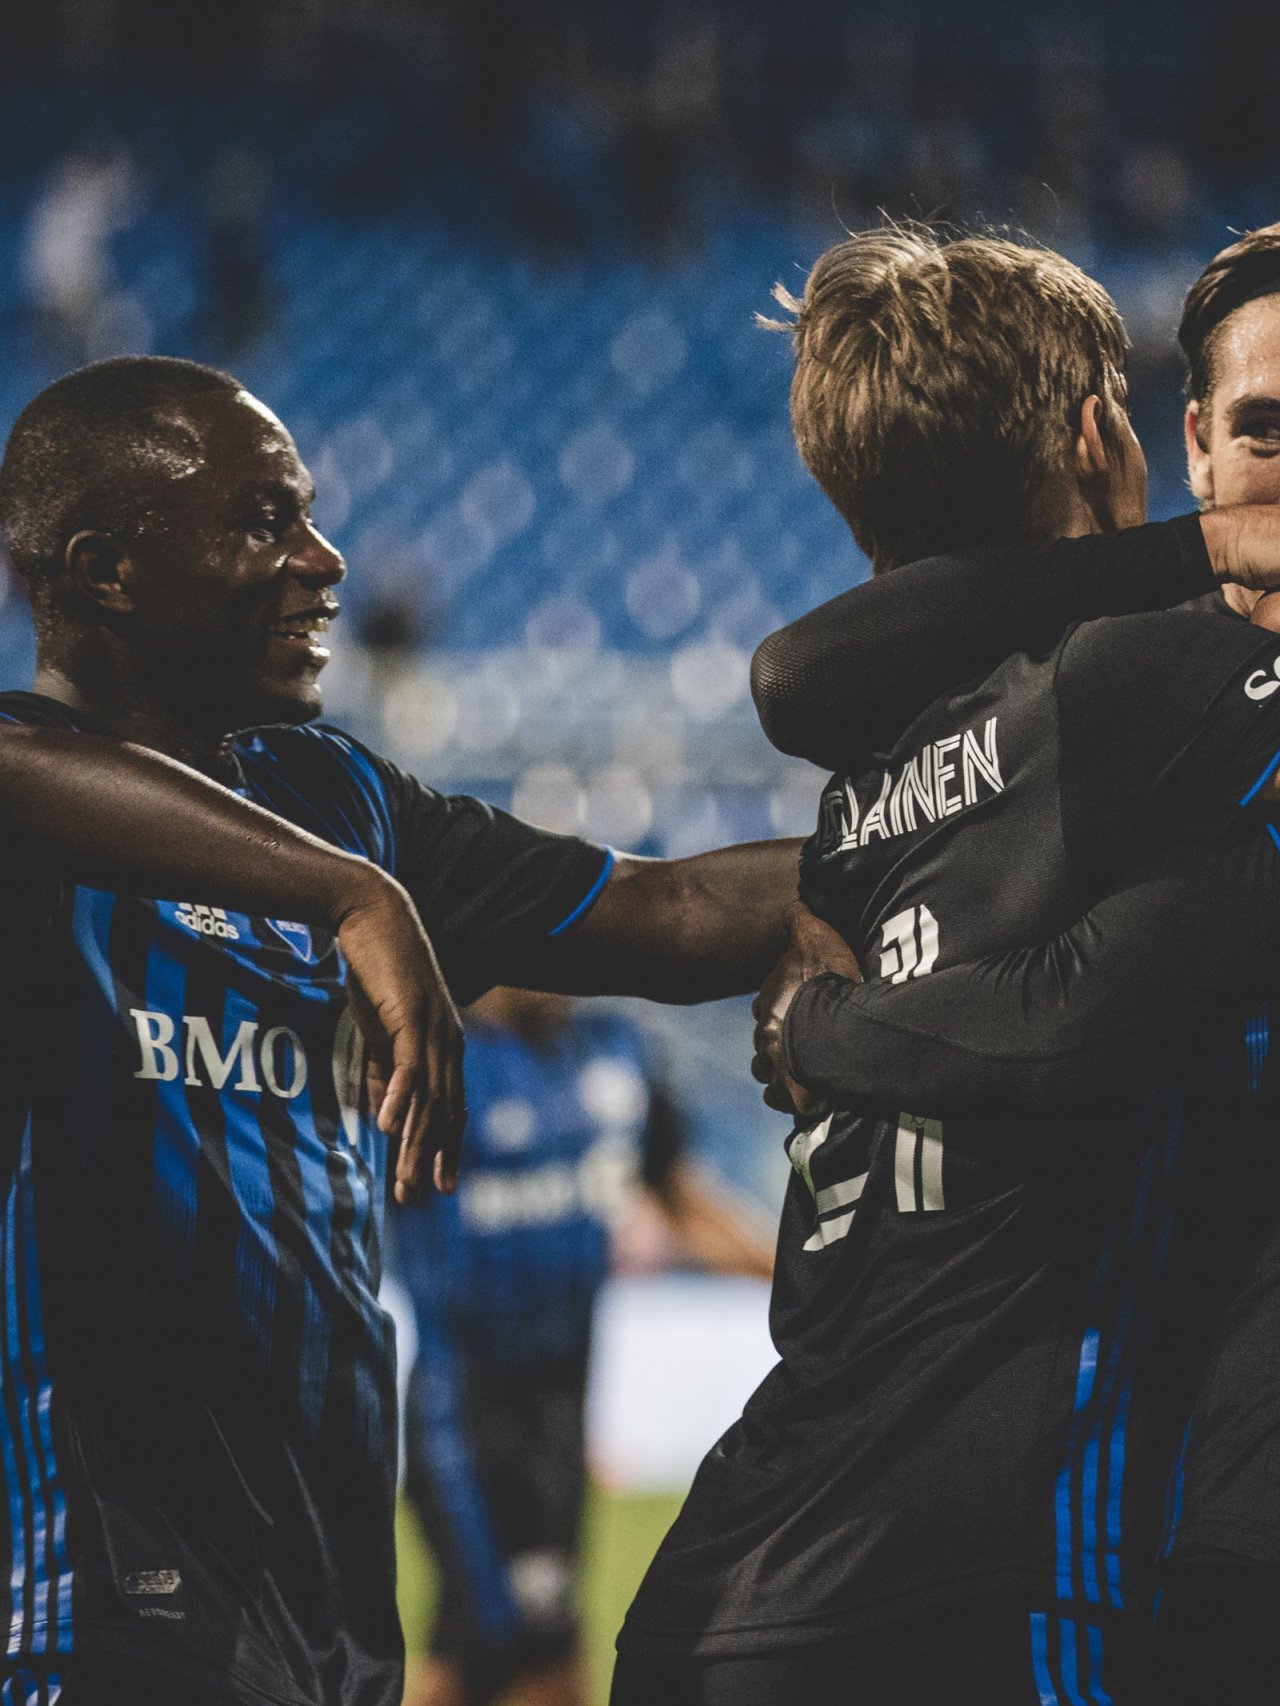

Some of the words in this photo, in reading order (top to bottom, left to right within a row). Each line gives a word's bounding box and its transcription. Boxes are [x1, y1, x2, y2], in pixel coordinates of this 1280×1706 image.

[822, 717, 1004, 854] LAINEN
[174, 910, 240, 940] adidas
[129, 1008, 308, 1099] BMO
